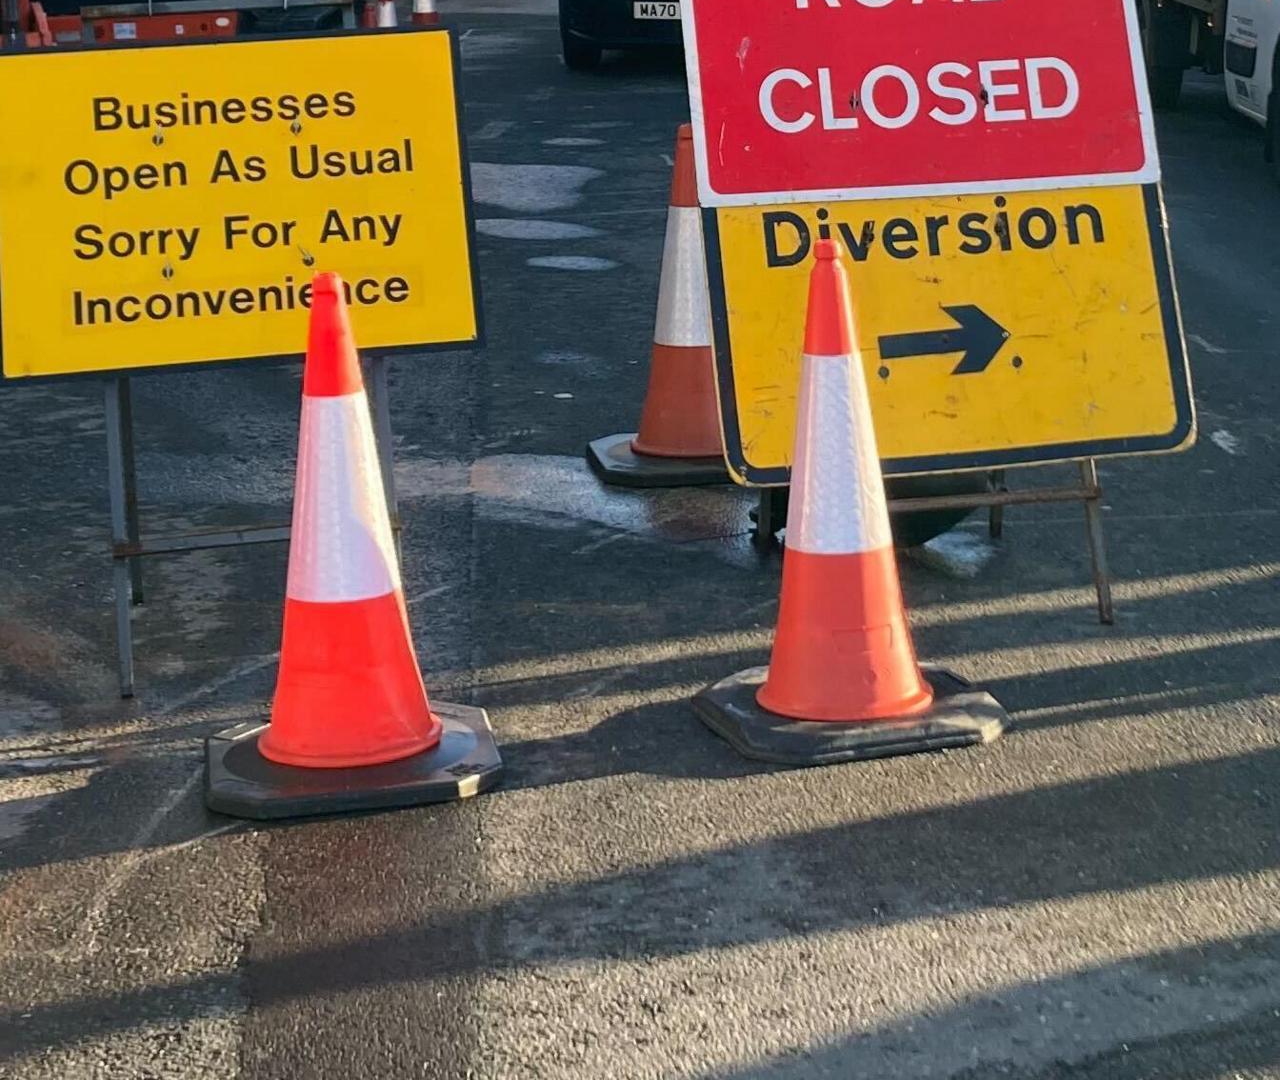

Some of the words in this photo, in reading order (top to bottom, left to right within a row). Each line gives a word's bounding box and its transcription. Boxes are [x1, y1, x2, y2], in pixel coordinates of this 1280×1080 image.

[639, 3, 677, 18] MA70
[92, 90, 357, 132] Businesses
[758, 55, 1081, 135] CLOSED
[64, 158, 188, 200] Open
[210, 149, 268, 185] As
[289, 138, 414, 181] Usual
[73, 223, 200, 262] Sorry
[223, 214, 297, 251] For
[319, 208, 403, 247] Any
[762, 195, 1106, 269] Diversion
